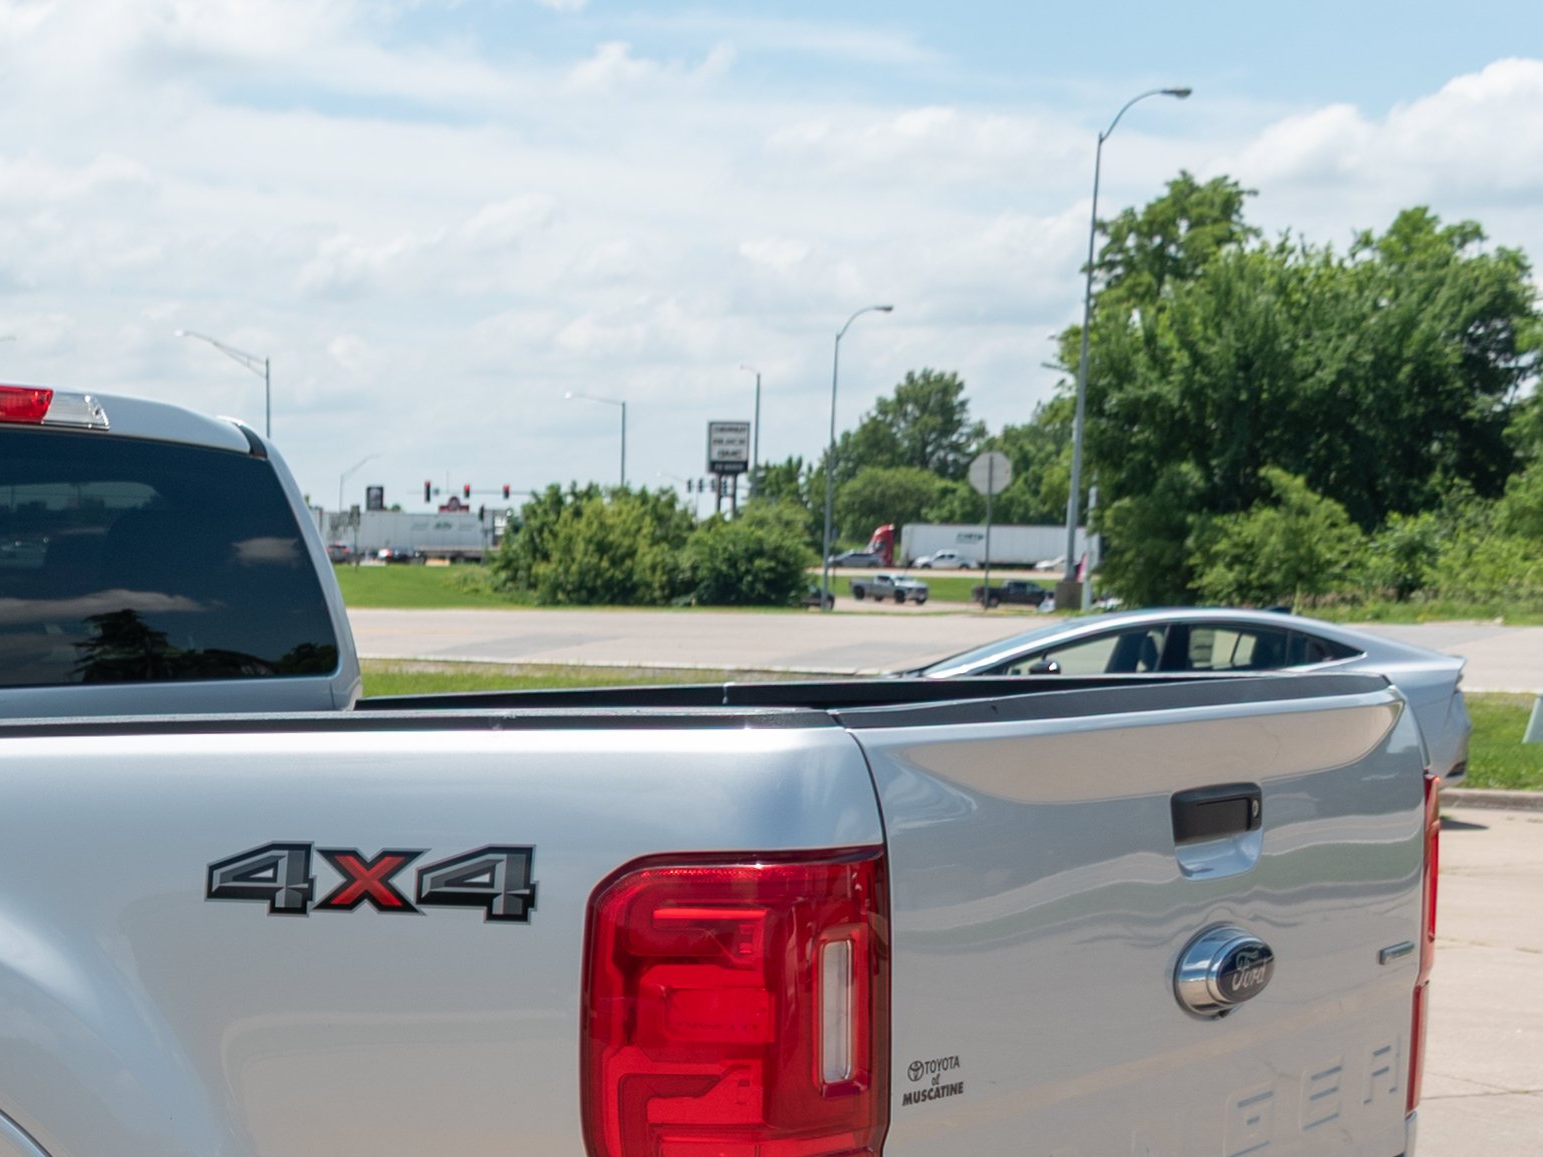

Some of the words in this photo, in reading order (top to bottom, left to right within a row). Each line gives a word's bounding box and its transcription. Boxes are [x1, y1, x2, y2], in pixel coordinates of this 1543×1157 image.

[1231, 951, 1267, 991] Ford
[925, 1055, 960, 1074] TOYOTA
[902, 1081, 964, 1106] MUSCATINE
